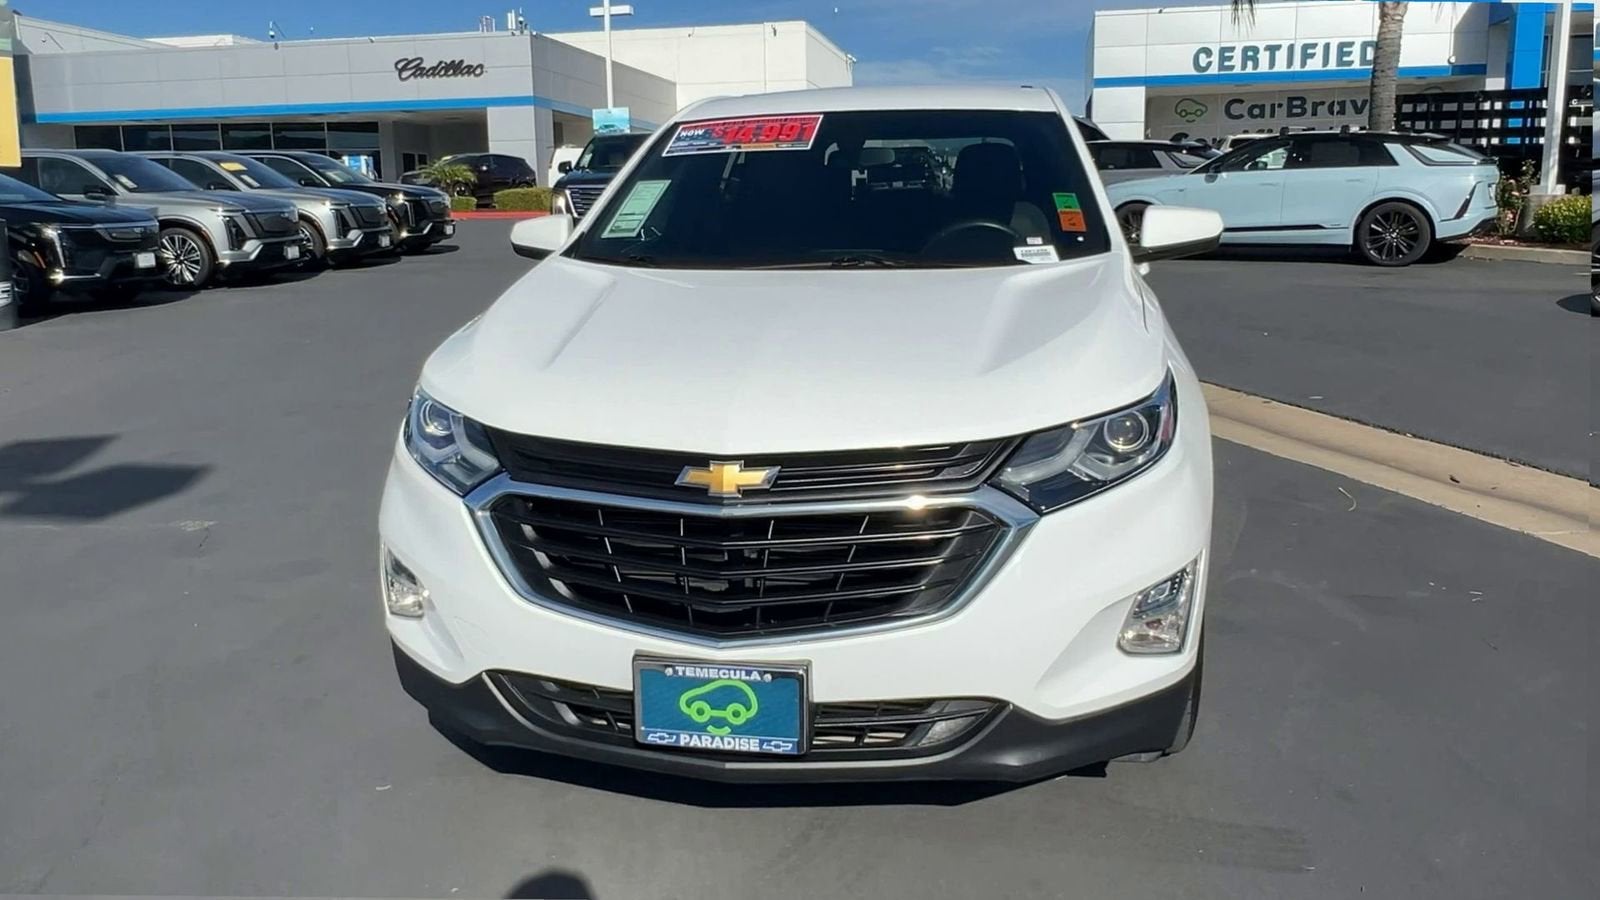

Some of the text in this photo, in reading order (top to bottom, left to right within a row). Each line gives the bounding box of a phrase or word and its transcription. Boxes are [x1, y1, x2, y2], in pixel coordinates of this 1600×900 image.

[1193, 41, 1377, 73] CERTIFIED
[394, 57, 485, 81] Cadillac
[1224, 96, 1369, 120] CarBrav
[680, 129, 706, 137] NOW
[675, 666, 762, 681] TEMECULA
[679, 733, 760, 751] PARADISE
